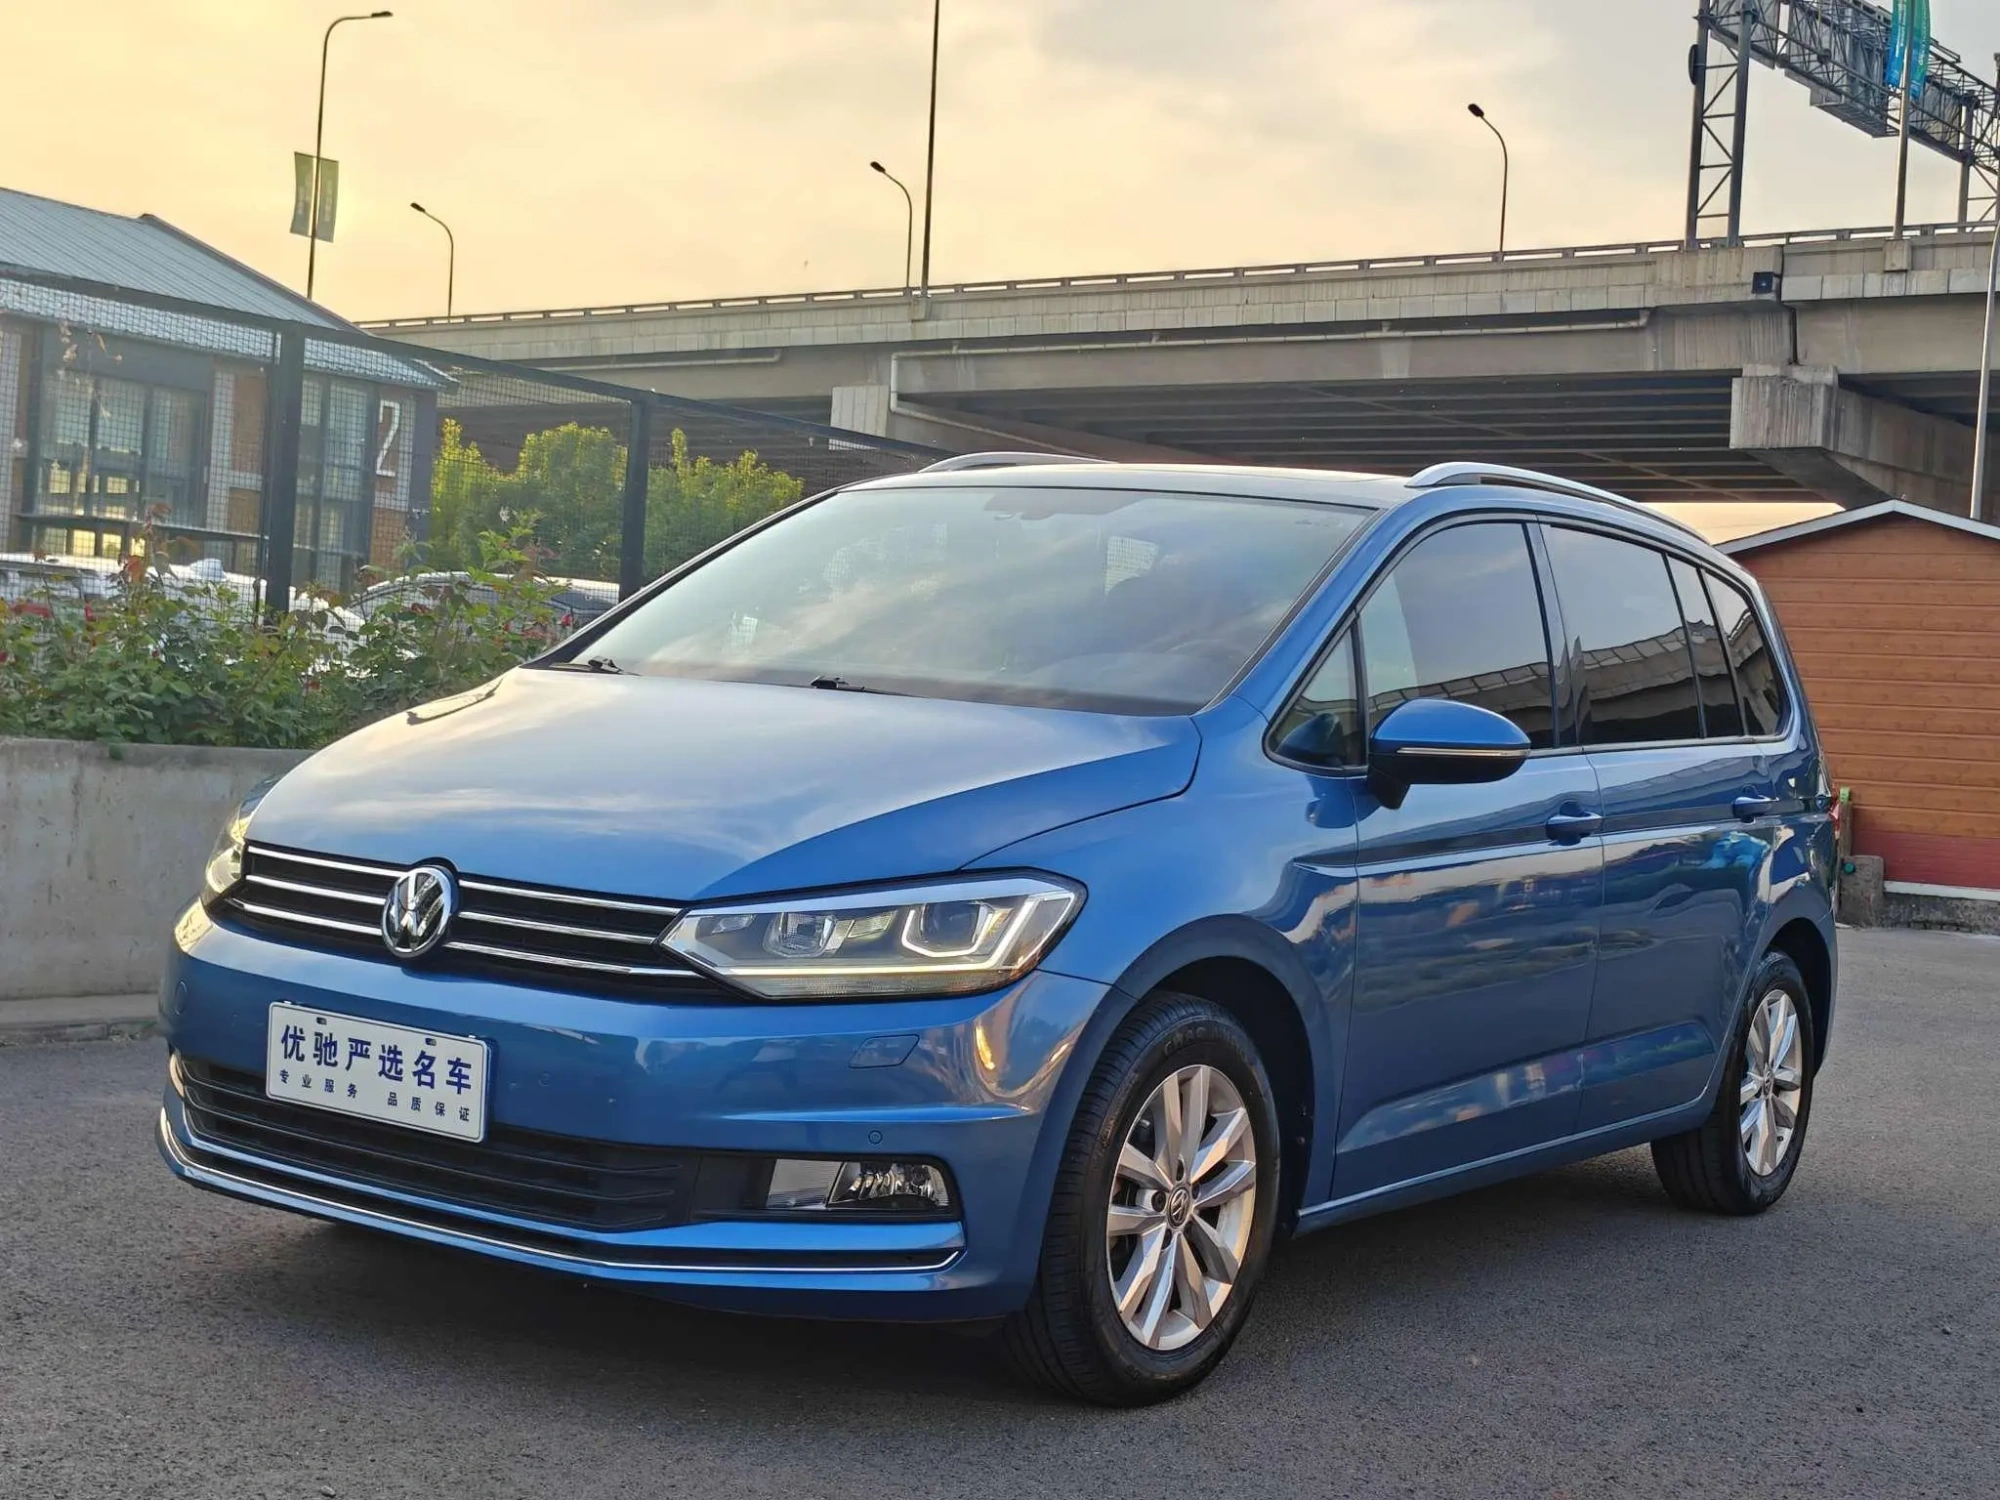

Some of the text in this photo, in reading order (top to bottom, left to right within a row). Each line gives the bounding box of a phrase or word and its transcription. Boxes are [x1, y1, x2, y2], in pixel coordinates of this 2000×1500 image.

[376, 400, 400, 477] 2
[281, 1024, 472, 1095] 优驰严选名车
[279, 1069, 470, 1123] 专业服务 品质保证
